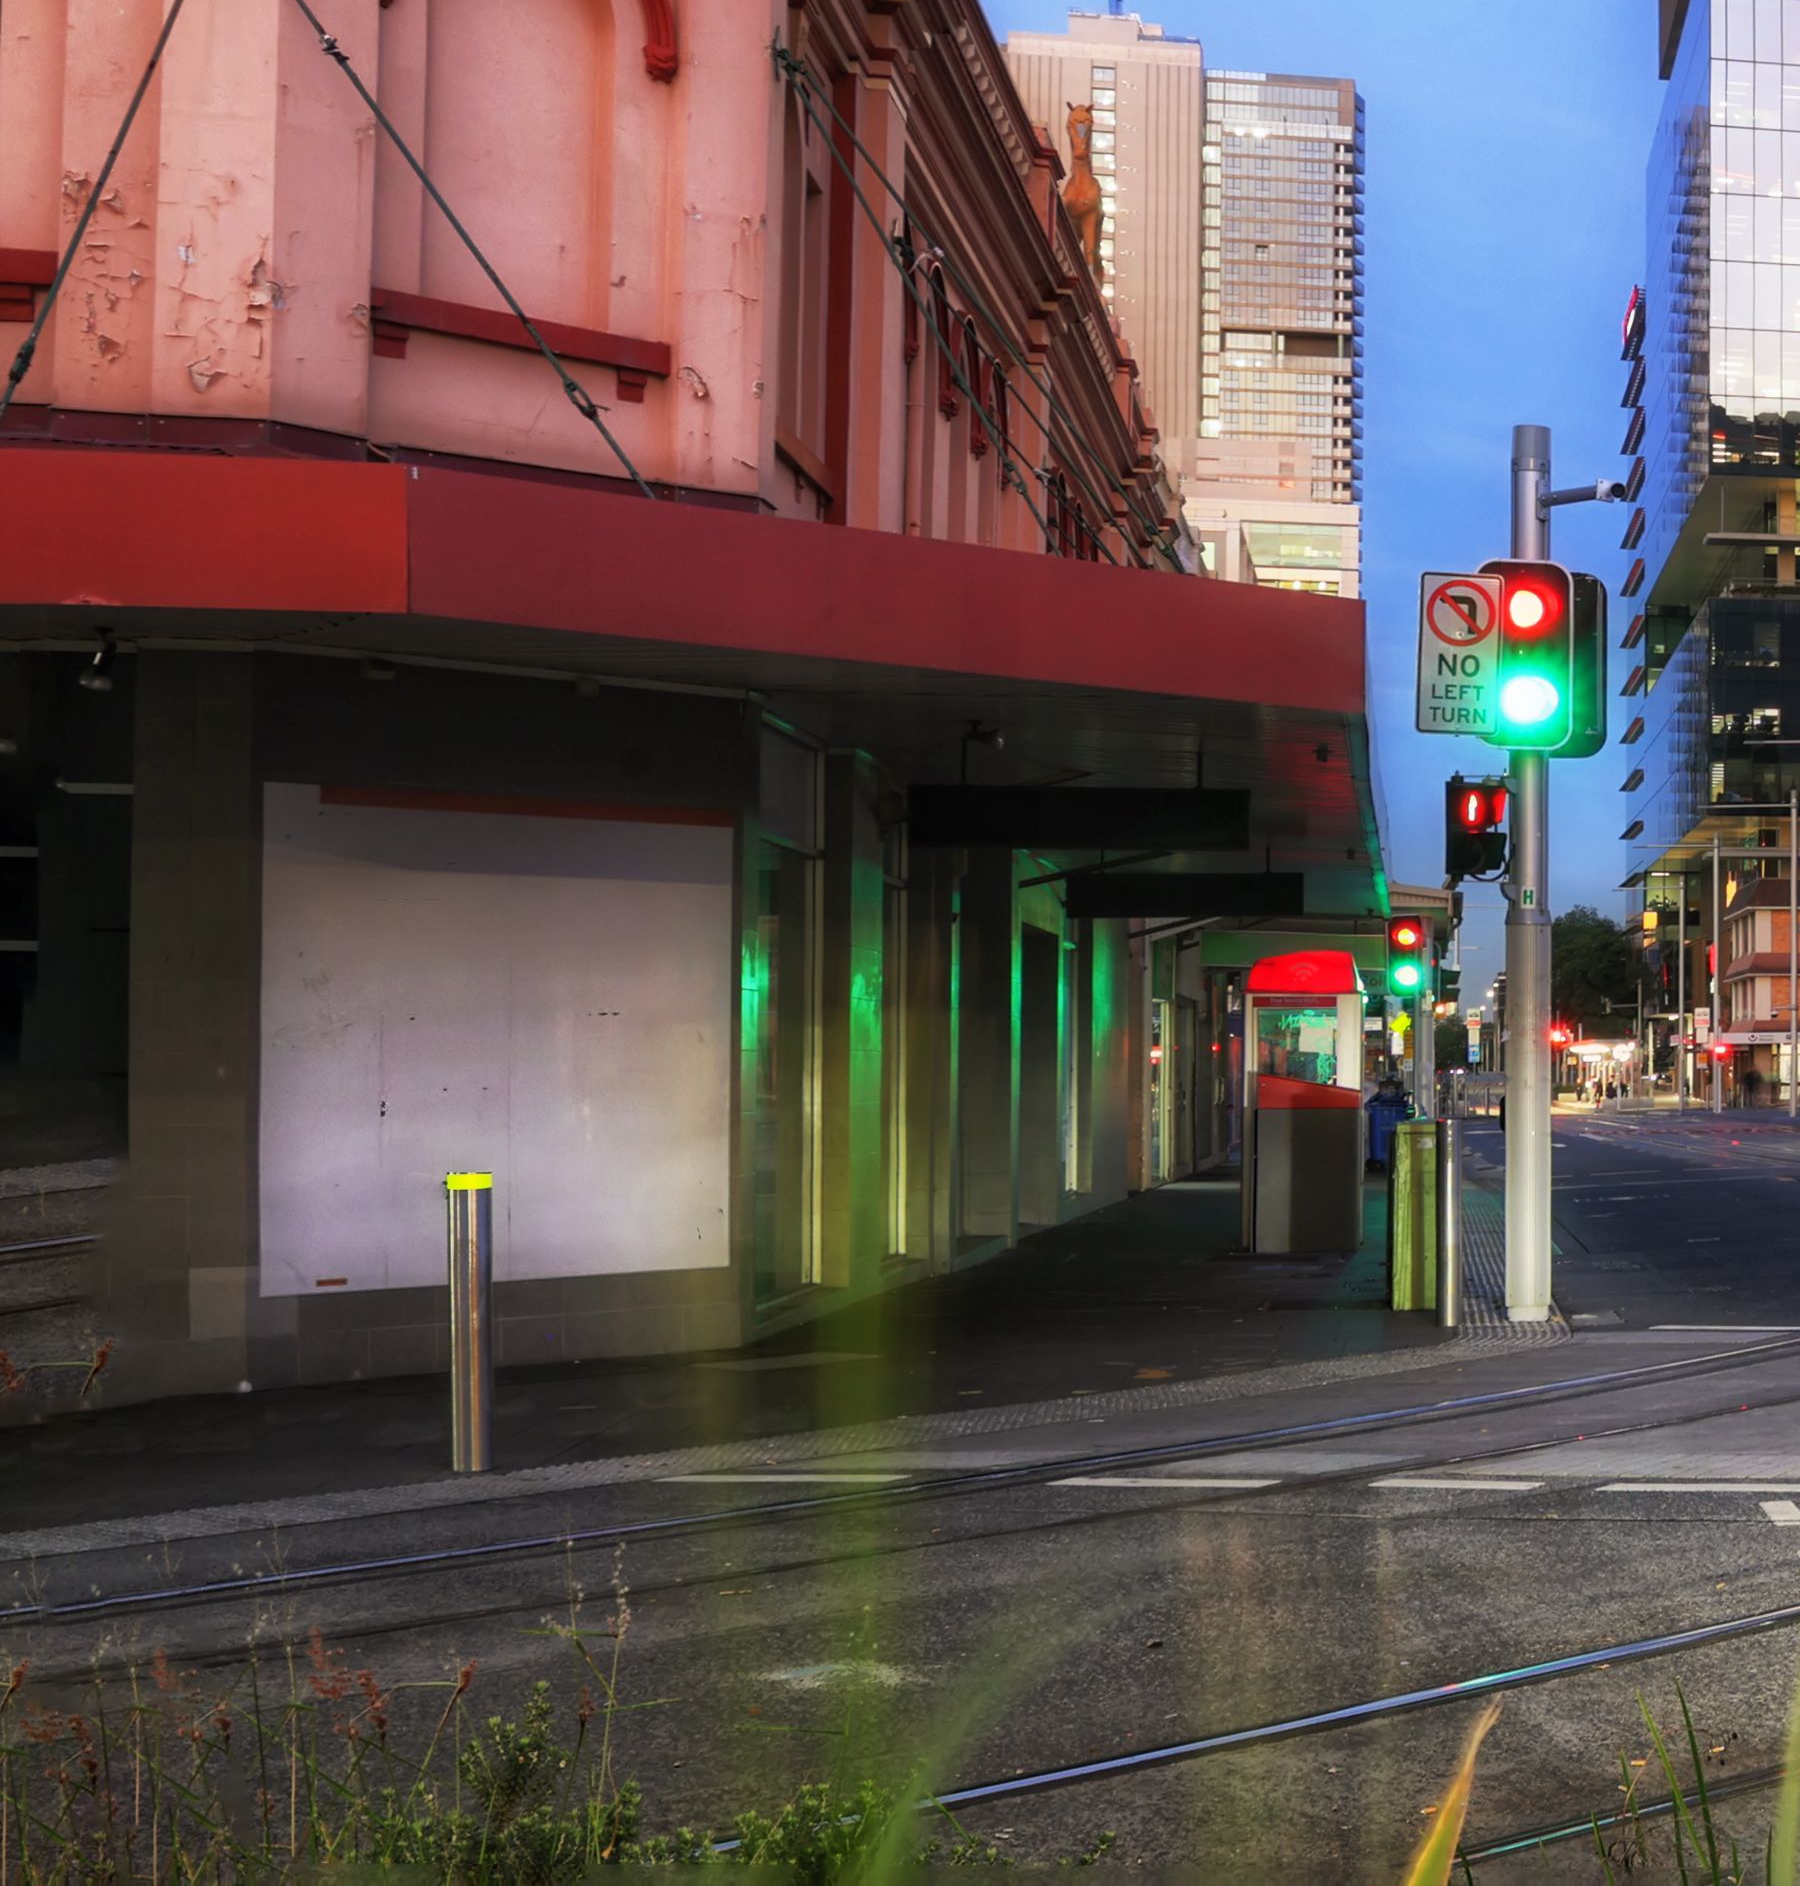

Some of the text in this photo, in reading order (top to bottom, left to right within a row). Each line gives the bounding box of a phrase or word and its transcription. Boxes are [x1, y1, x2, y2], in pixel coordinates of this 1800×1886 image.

[1437, 653, 1480, 678] NO
[1432, 683, 1485, 701] LEFT
[1429, 706, 1487, 724] TURN
[1523, 889, 1534, 905] H
